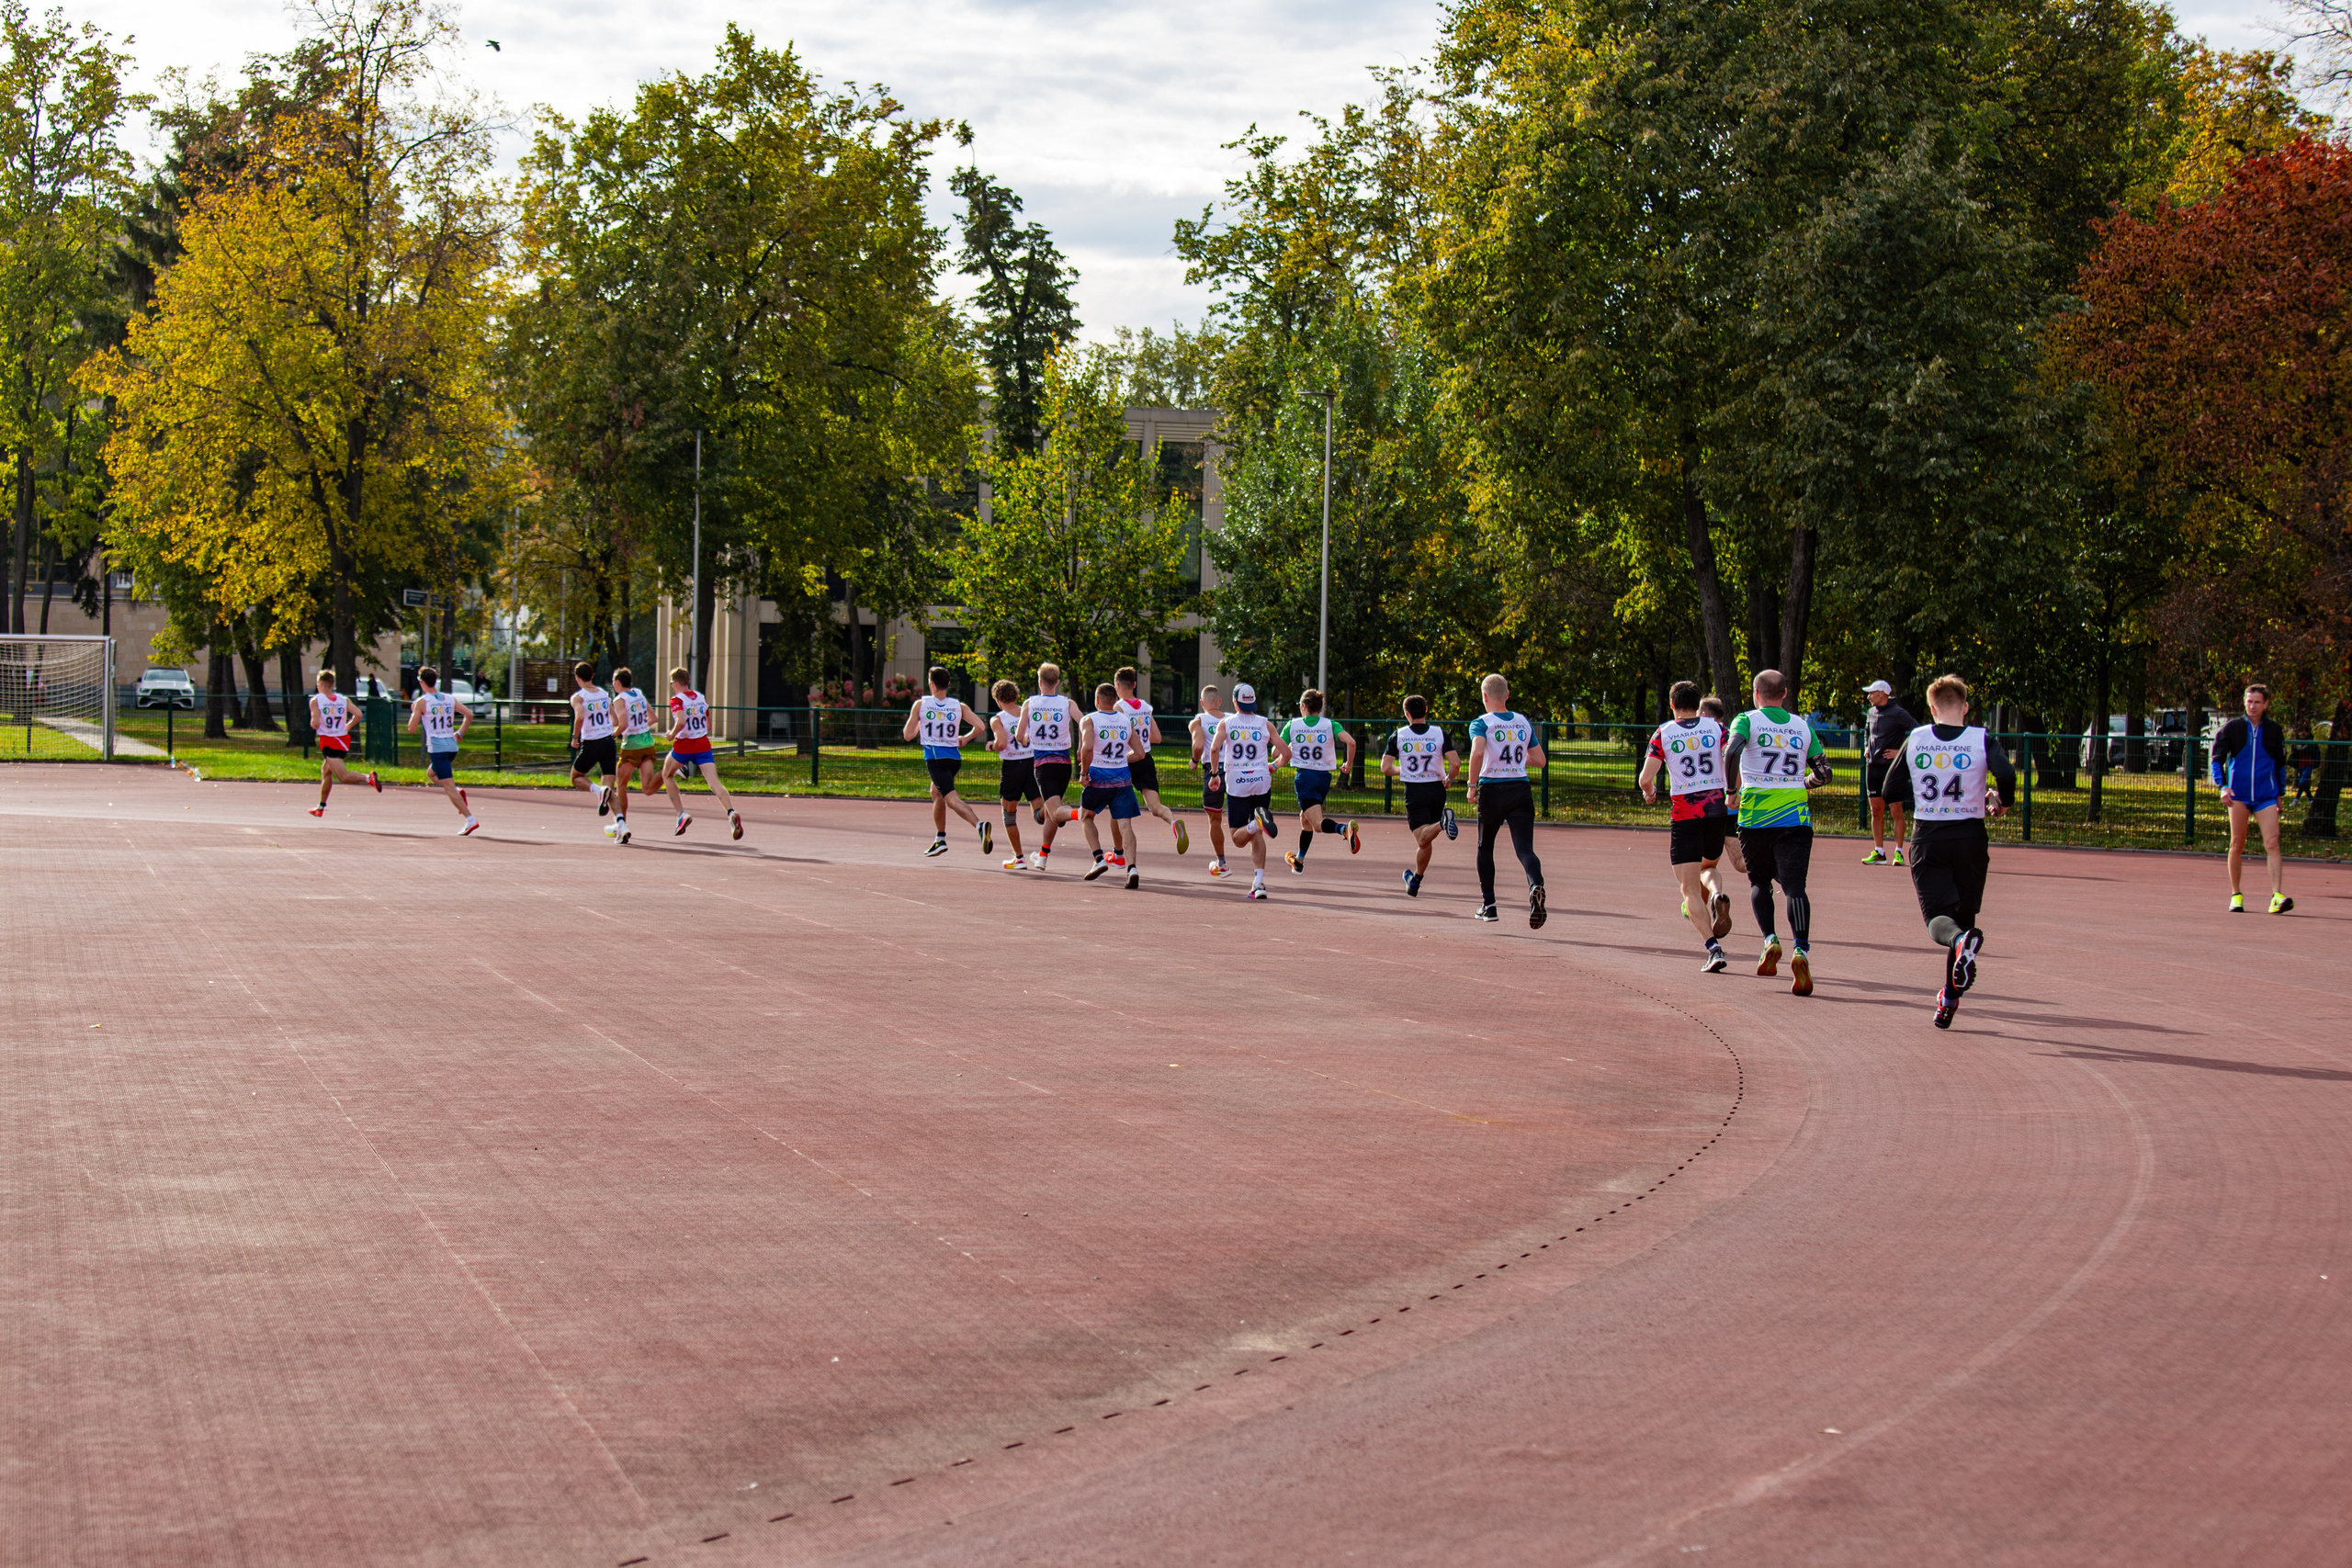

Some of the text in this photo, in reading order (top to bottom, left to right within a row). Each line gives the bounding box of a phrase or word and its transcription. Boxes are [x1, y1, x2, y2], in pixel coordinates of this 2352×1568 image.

[325, 716, 342, 728] 97
[430, 716, 453, 729] 113
[588, 711, 610, 727] 101
[925, 722, 956, 739] 119
[1035, 724, 1058, 739] 43
[1668, 729, 1713, 740] VMARAFONE
[1758, 727, 1803, 737] VMARAFONE
[1101, 742, 1125, 759] 42
[1232, 743, 1257, 760] 99
[1299, 746, 1323, 761] 66
[1498, 744, 1523, 764] 46
[1408, 755, 1432, 772] 37
[1679, 751, 1713, 778] 35
[1761, 750, 1799, 775] 75
[1920, 773, 1964, 802] 34
